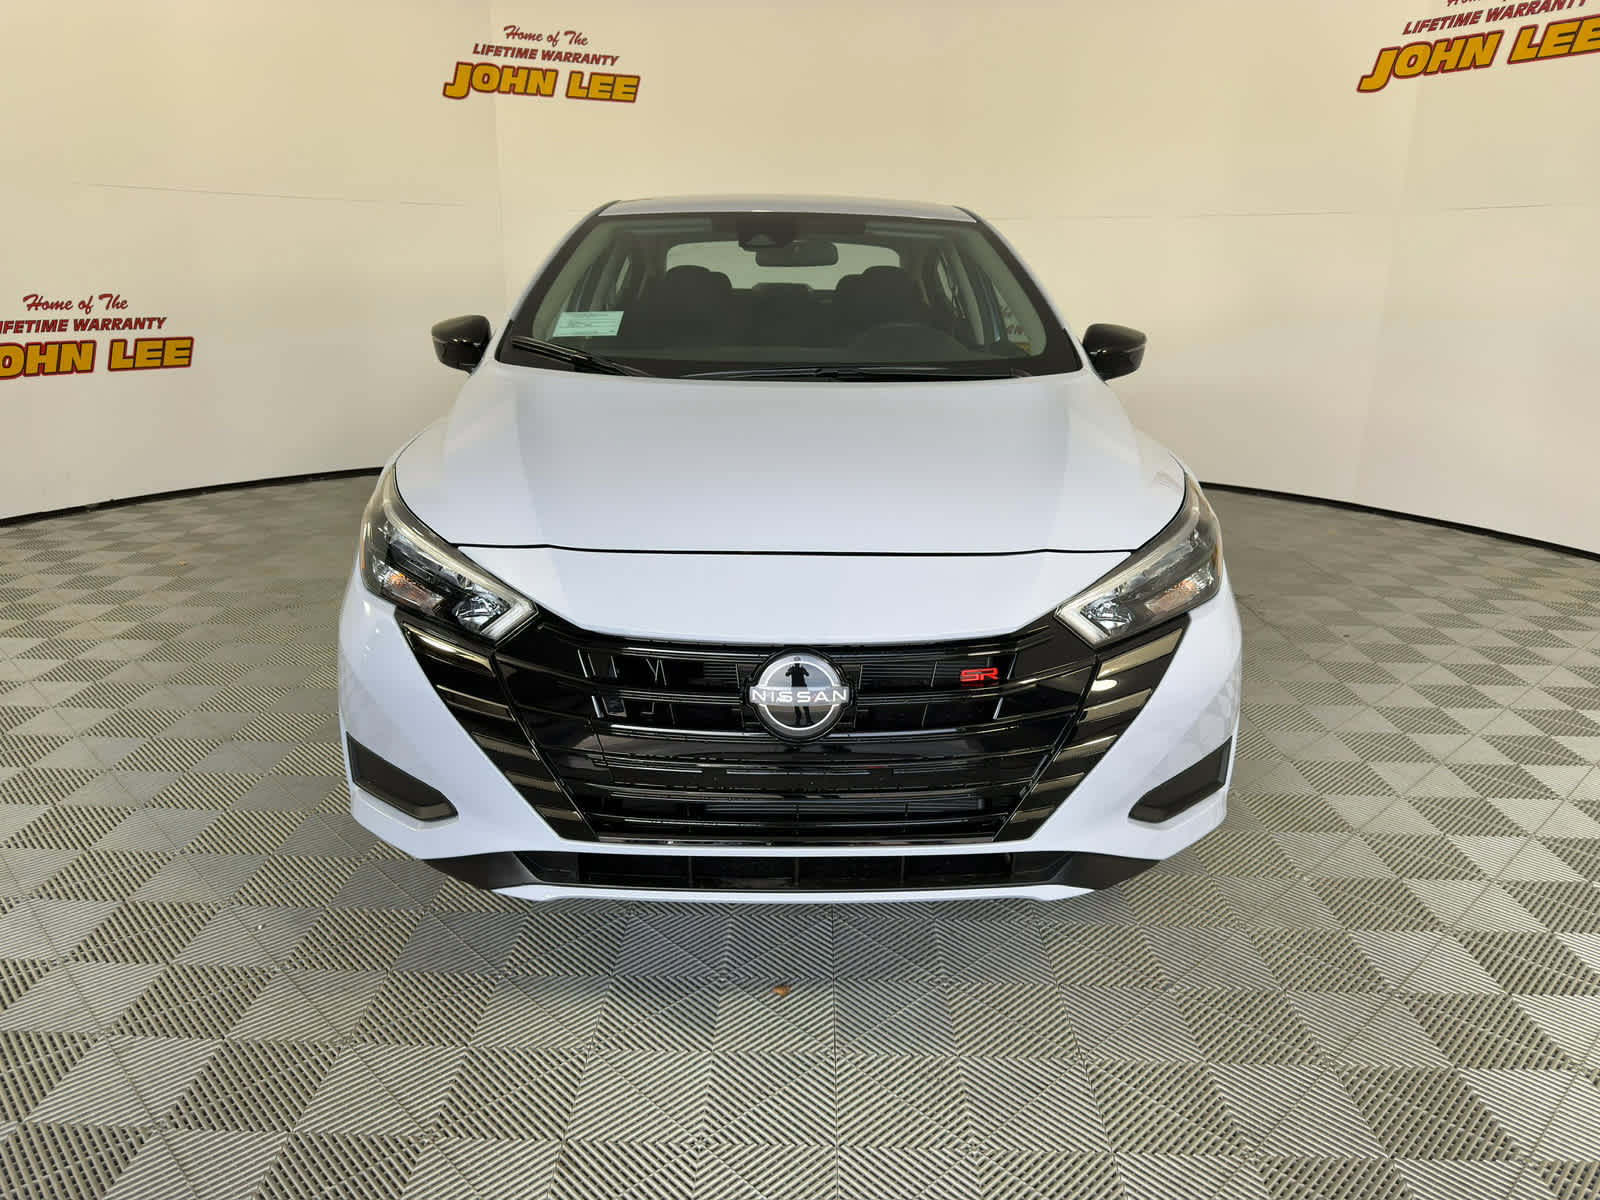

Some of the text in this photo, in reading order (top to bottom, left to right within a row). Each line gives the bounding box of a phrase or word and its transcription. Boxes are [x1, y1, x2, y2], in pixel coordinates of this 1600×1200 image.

[1402, 10, 1484, 35] LIFETIME
[504, 25, 588, 47] Home of The
[472, 43, 620, 66] LIFETIME WARRANTY
[1357, 13, 1600, 93] JOHN LEE
[443, 62, 640, 103] JOHN LEE
[22, 293, 128, 314] Home of The
[0, 317, 167, 334] IFETIME WARRANTY
[0, 336, 194, 380] OHN LEE
[960, 667, 999, 682] SR
[752, 689, 847, 703] NISSAN
